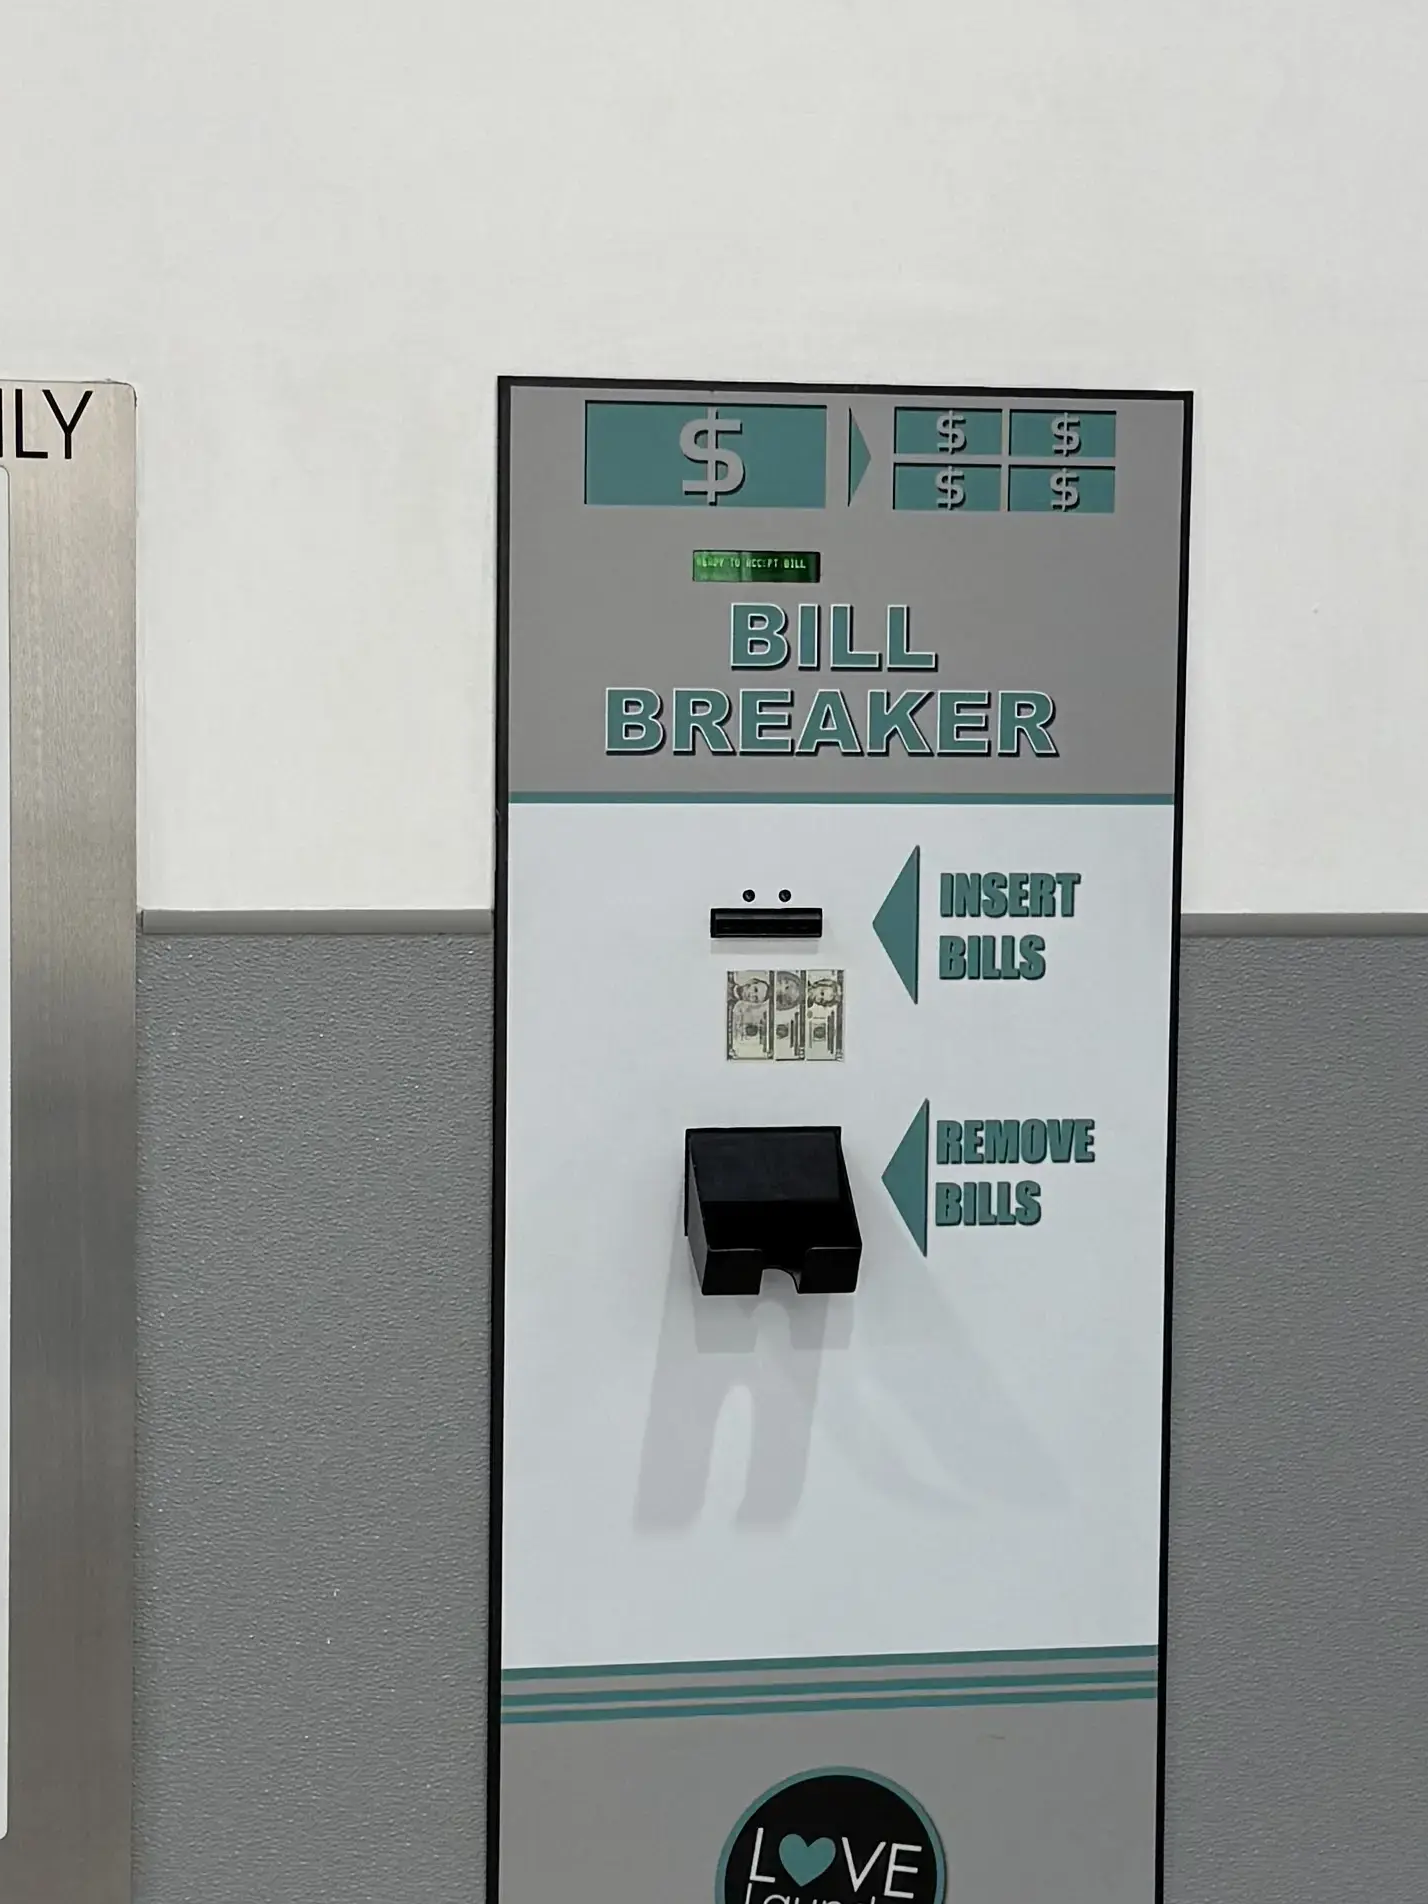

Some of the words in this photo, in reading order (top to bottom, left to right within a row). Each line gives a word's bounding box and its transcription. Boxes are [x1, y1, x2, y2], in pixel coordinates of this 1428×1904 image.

[730, 602, 938, 672] BILL
[605, 687, 1060, 758] BREAKER
[940, 872, 1082, 918] INSERT
[939, 934, 1047, 980] BILLS
[936, 1119, 1095, 1165] REMOVE
[935, 1180, 1042, 1227] BILLS
